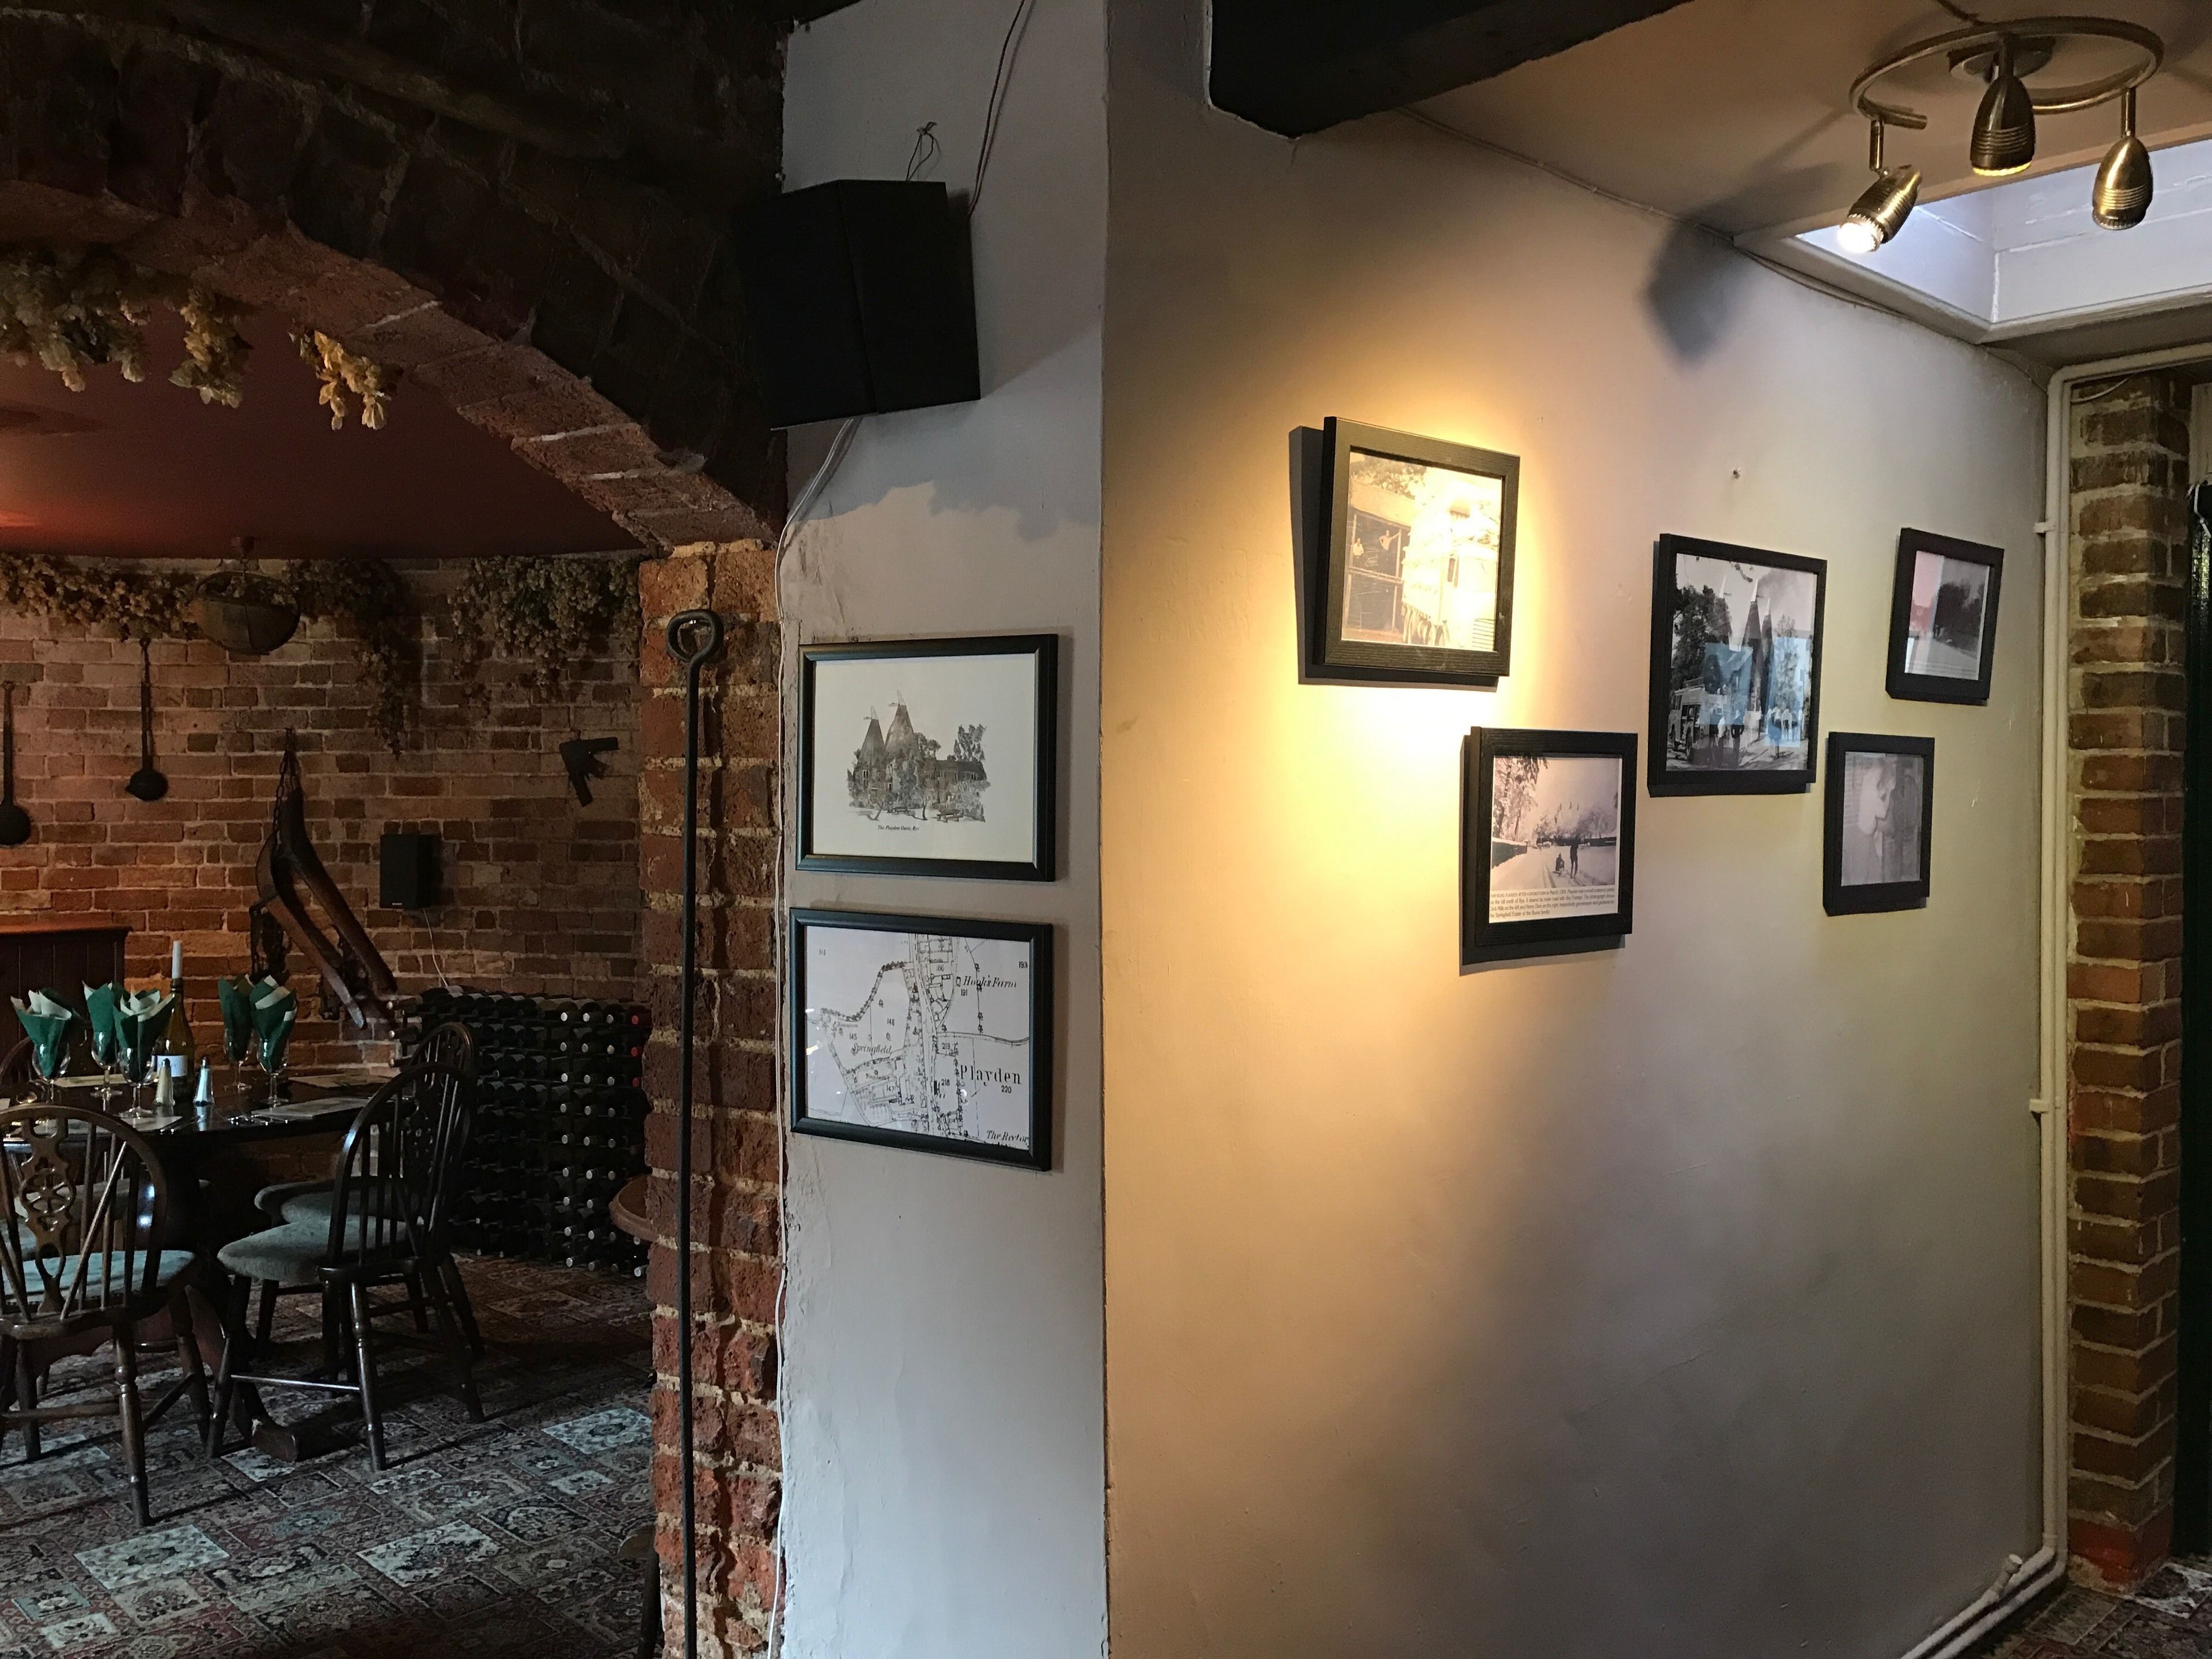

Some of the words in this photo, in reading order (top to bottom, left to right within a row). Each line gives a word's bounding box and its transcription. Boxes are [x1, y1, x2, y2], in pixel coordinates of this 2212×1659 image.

[992, 977, 1016, 988] Farm
[960, 1065, 1022, 1087] Playden
[1001, 1085, 1012, 1093] 220
[987, 1130, 1001, 1140] The
[1002, 1131, 1029, 1145] Rector
